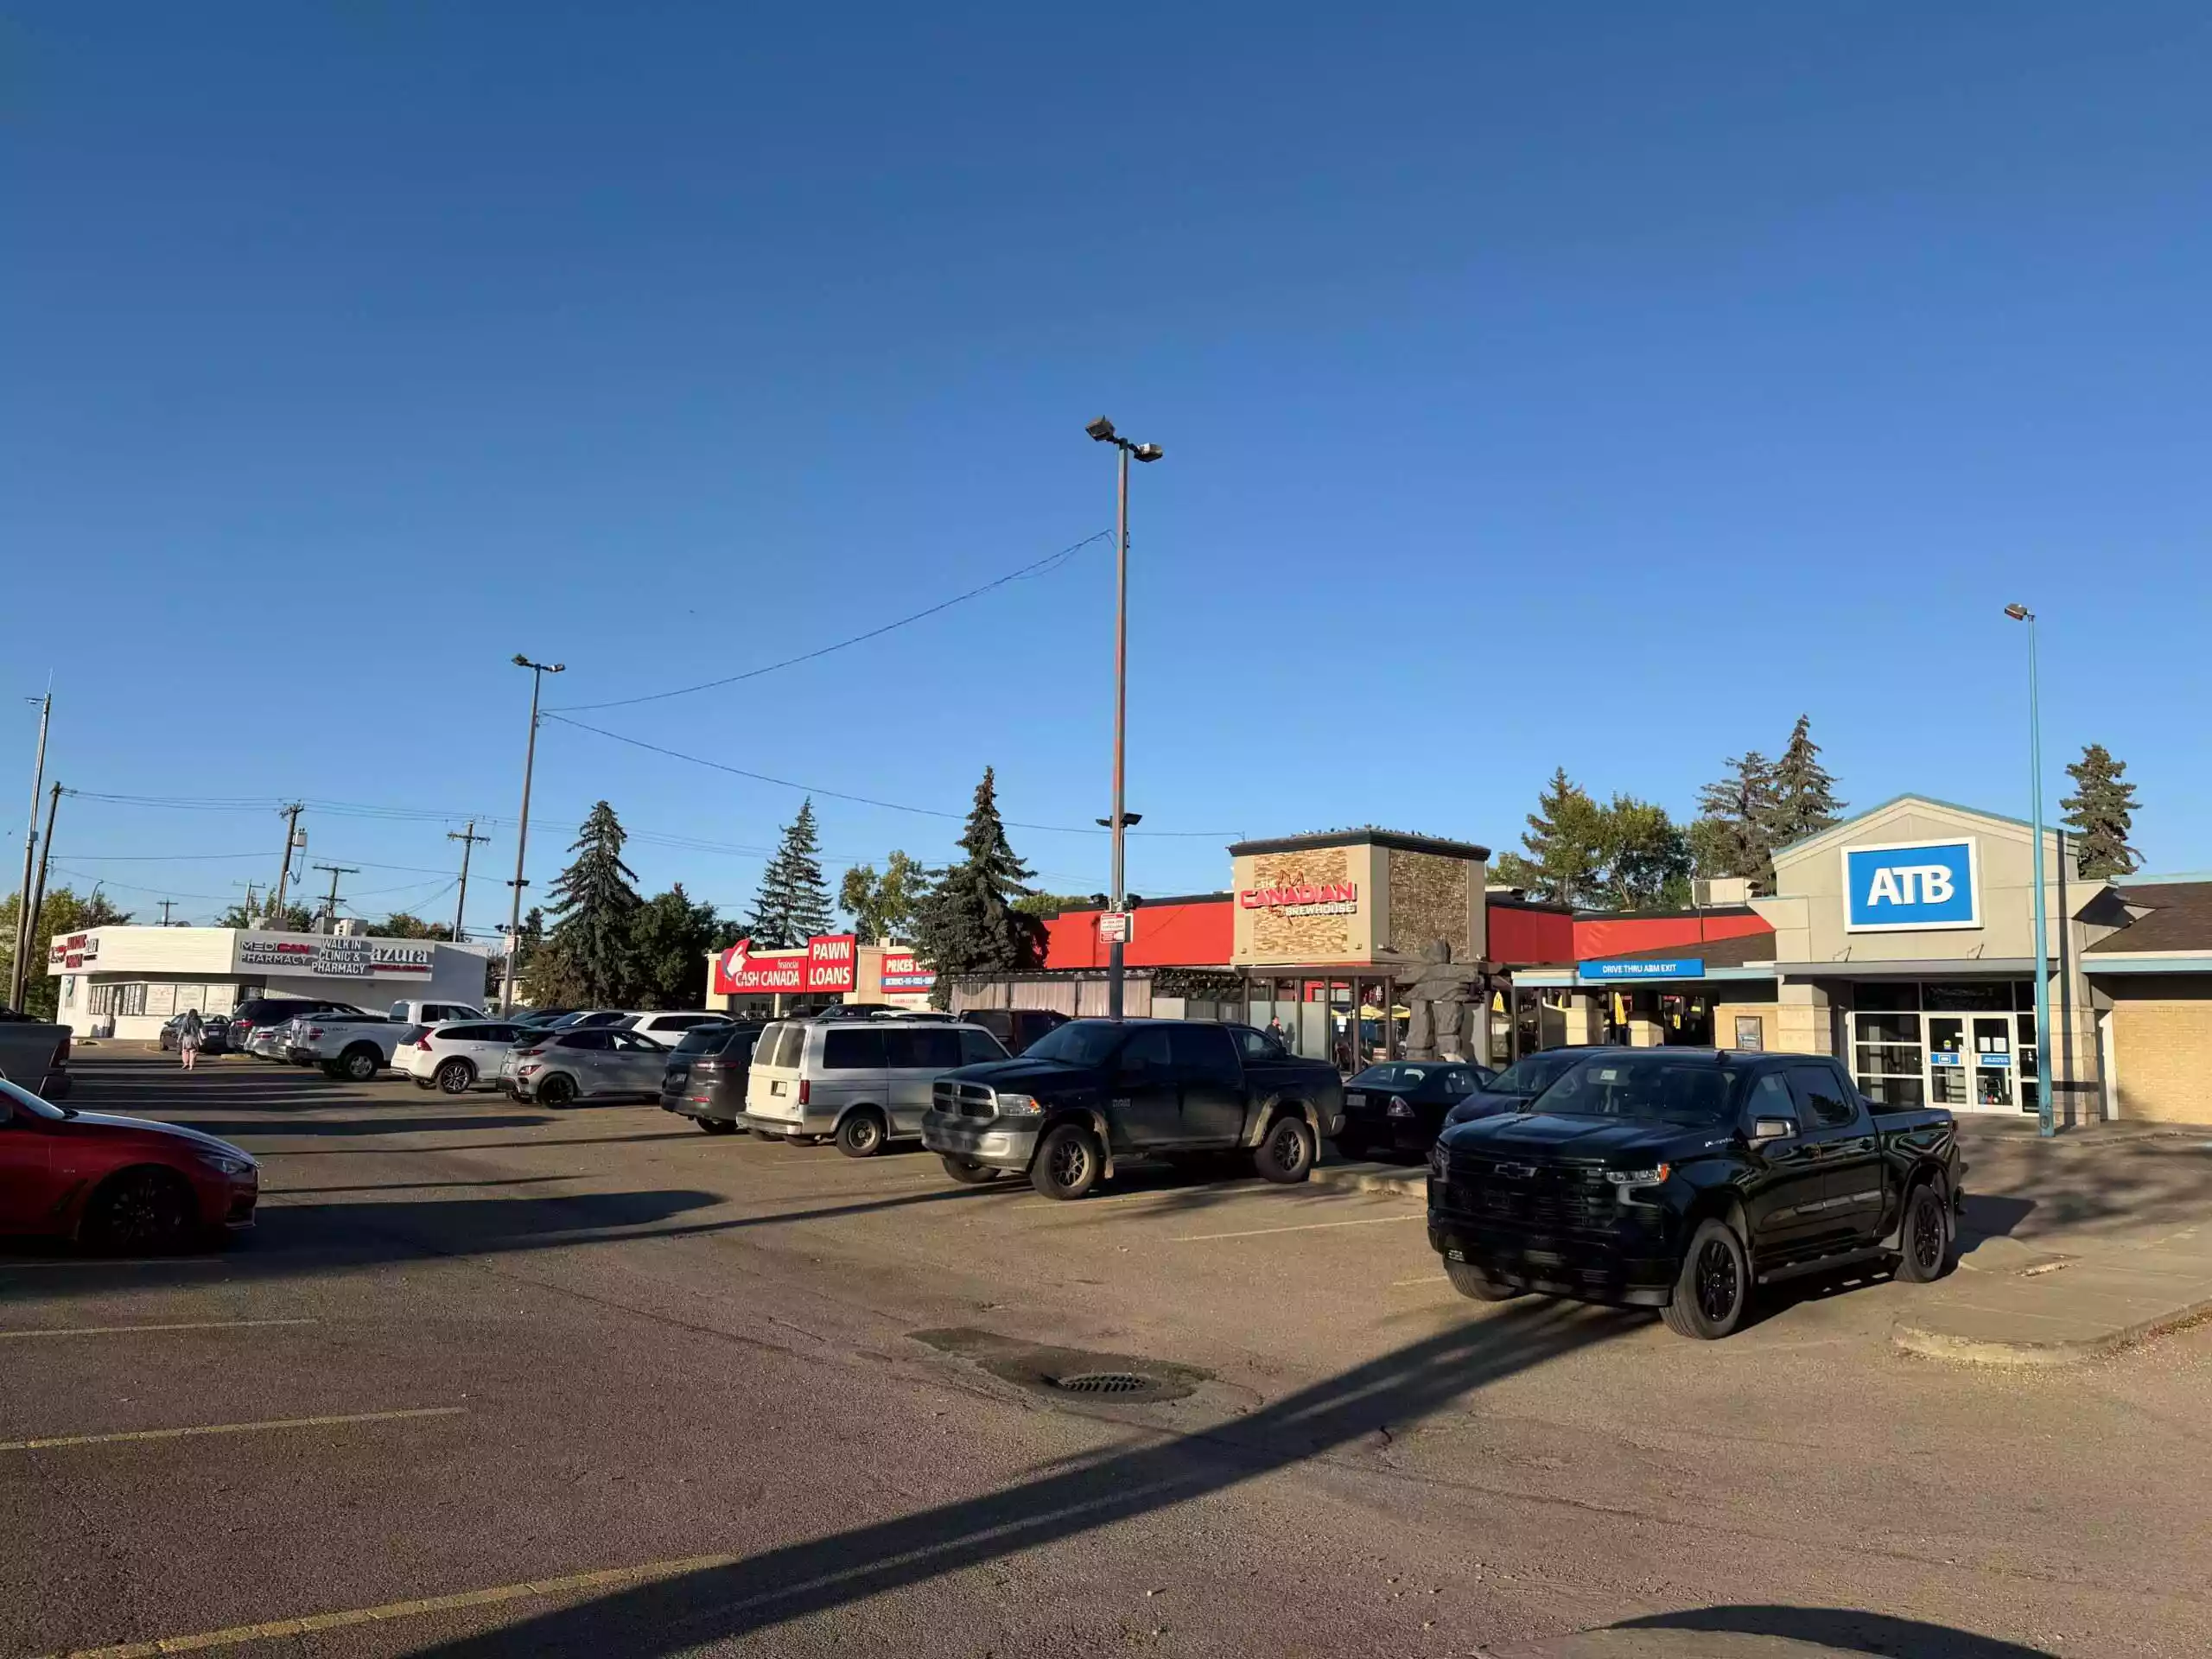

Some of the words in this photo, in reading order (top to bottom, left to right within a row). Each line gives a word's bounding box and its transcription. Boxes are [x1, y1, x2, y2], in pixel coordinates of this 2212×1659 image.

[1867, 865, 1955, 906] ATB
[1240, 882, 1357, 908] CANADIAN
[1285, 902, 1356, 916] BREWHOUSE
[321, 938, 350, 950] WALK
[352, 939, 361, 950] IN
[319, 950, 350, 961] CLINIC
[353, 953, 360, 962] &
[371, 947, 428, 963] azura
[813, 942, 849, 961] PAWN
[240, 953, 308, 965] PHARMACY
[778, 960, 799, 969] financial
[886, 959, 913, 973] PRICES
[311, 962, 365, 974] PHARMACY
[1602, 965, 1622, 974] DRIVE
[1624, 965, 1642, 974] THRU
[735, 971, 759, 987] CASH
[760, 970, 799, 986] CANADA
[810, 967, 850, 985] LOANS
